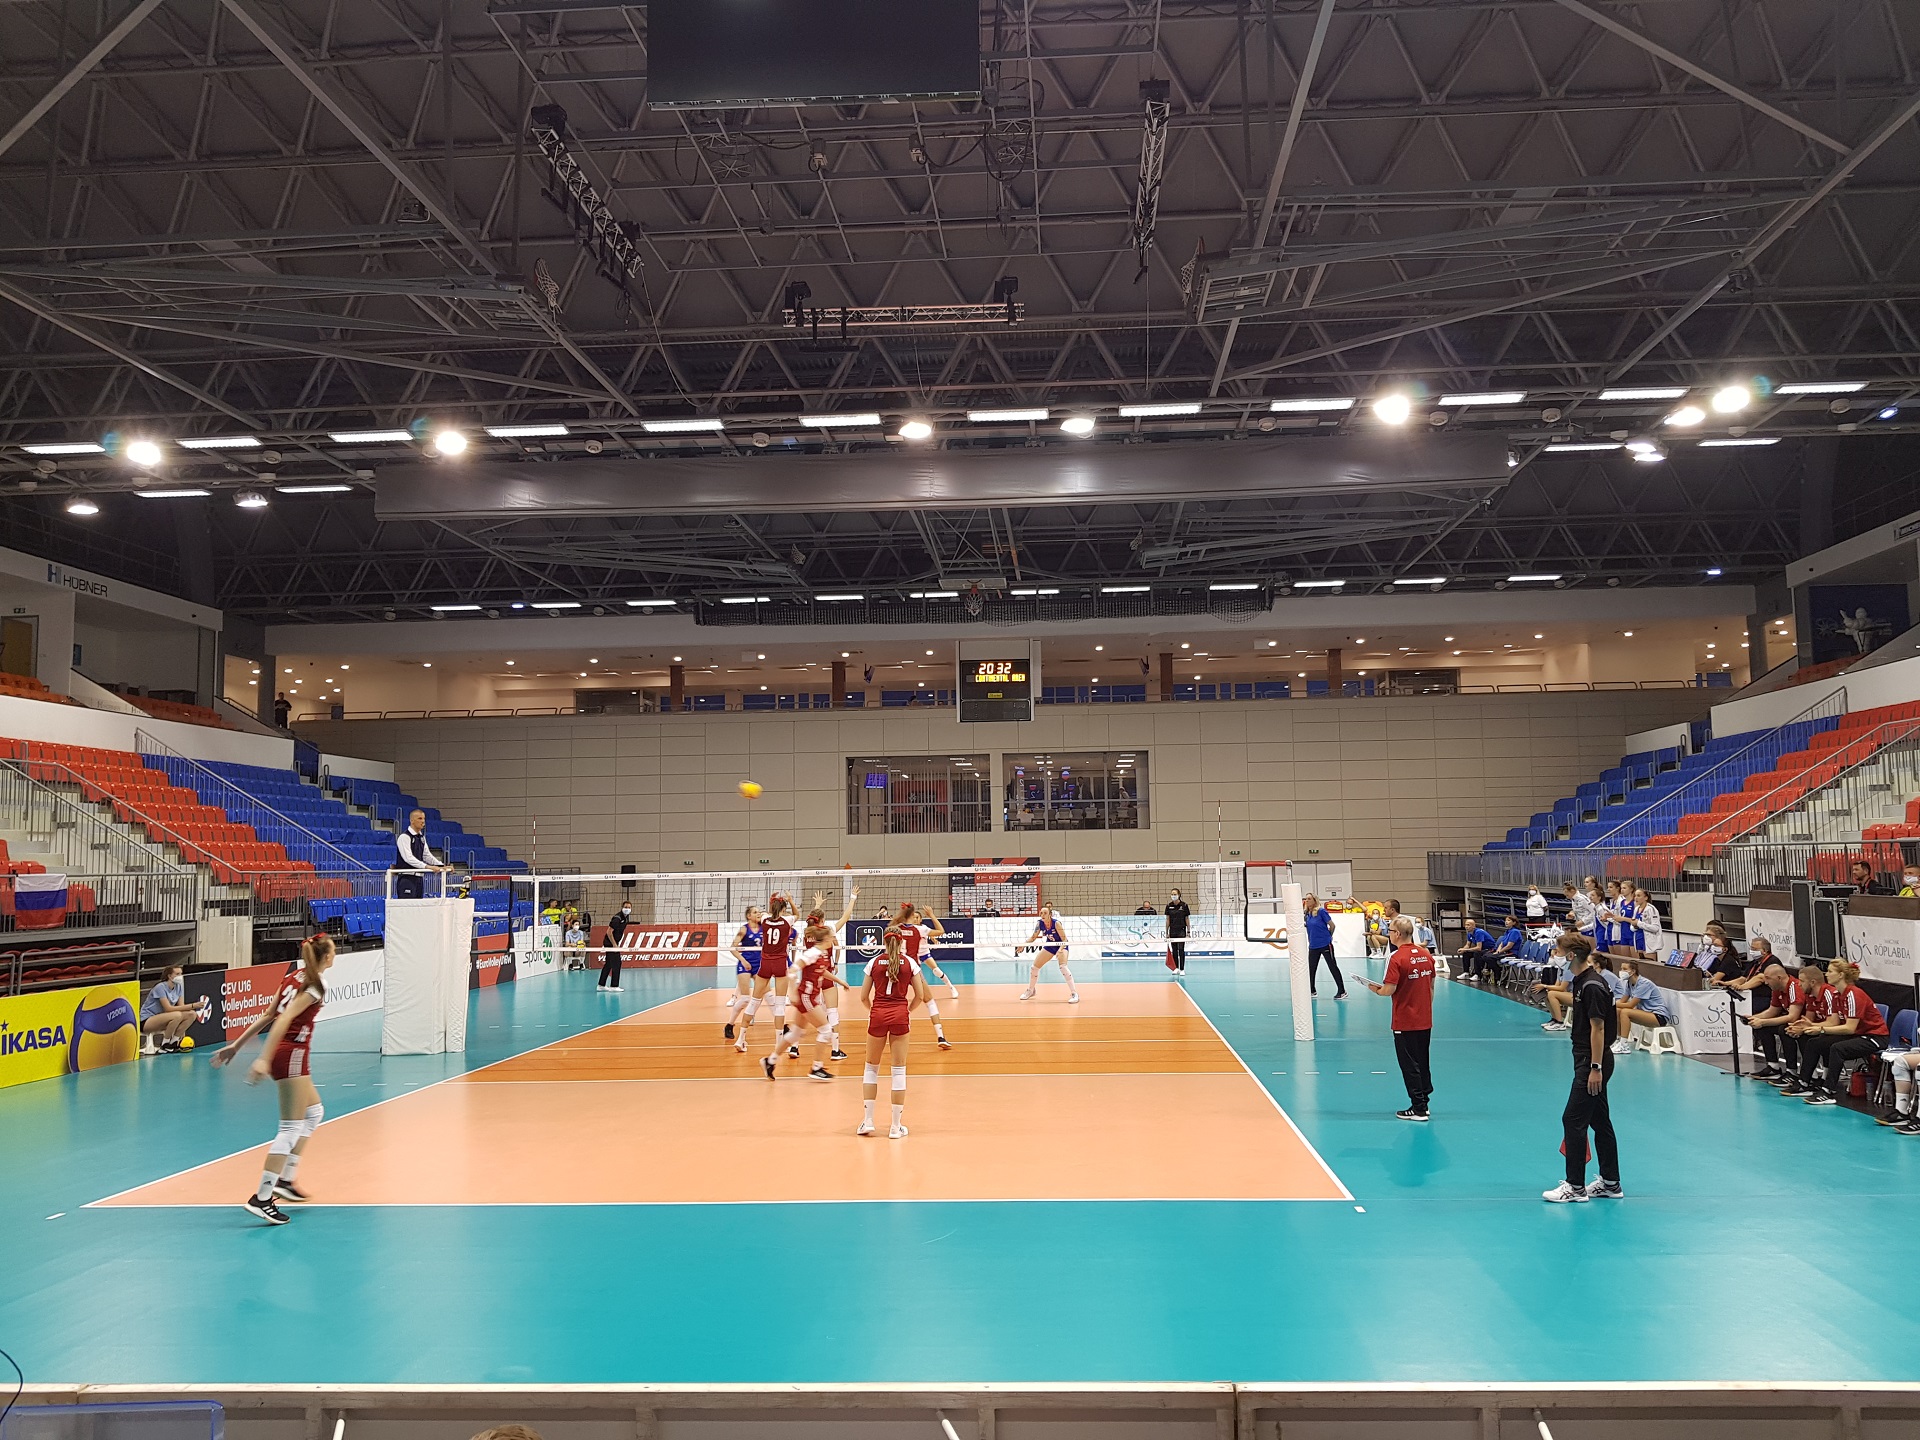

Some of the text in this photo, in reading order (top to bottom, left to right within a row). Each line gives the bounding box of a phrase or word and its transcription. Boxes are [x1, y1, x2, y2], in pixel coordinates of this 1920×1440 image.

[63, 574, 108, 597] HÜBNER
[602, 931, 708, 951] UTRIA
[766, 927, 780, 945] 19
[635, 953, 651, 961] THE
[1873, 943, 1911, 960] RÖPLABDA
[220, 980, 252, 995] CEV U16
[220, 994, 257, 1013] Volleyball
[1693, 1028, 1739, 1038] RÖPLABD
